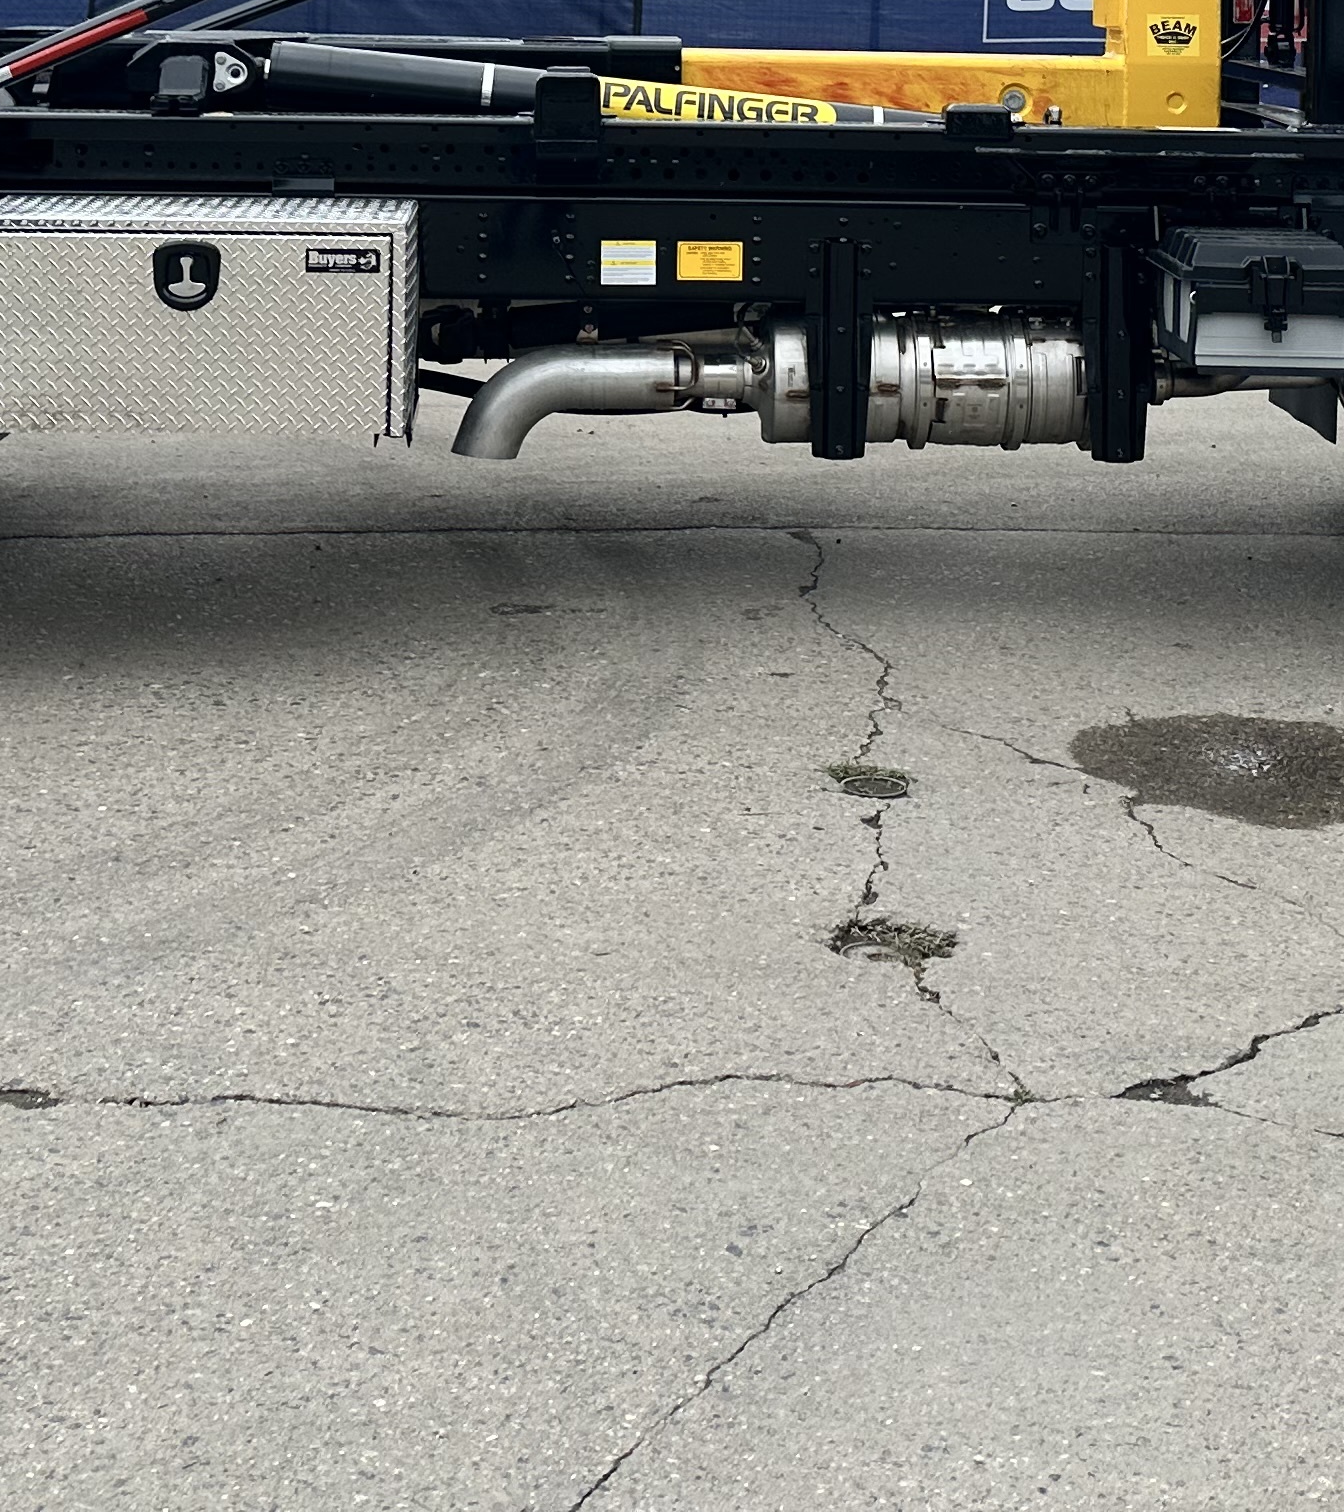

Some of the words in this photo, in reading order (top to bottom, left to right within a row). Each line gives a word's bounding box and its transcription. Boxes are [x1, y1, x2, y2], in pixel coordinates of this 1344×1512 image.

[1149, 20, 1197, 37] BEAM
[602, 82, 819, 123] PALFINGER
[308, 250, 357, 267] Buyers
